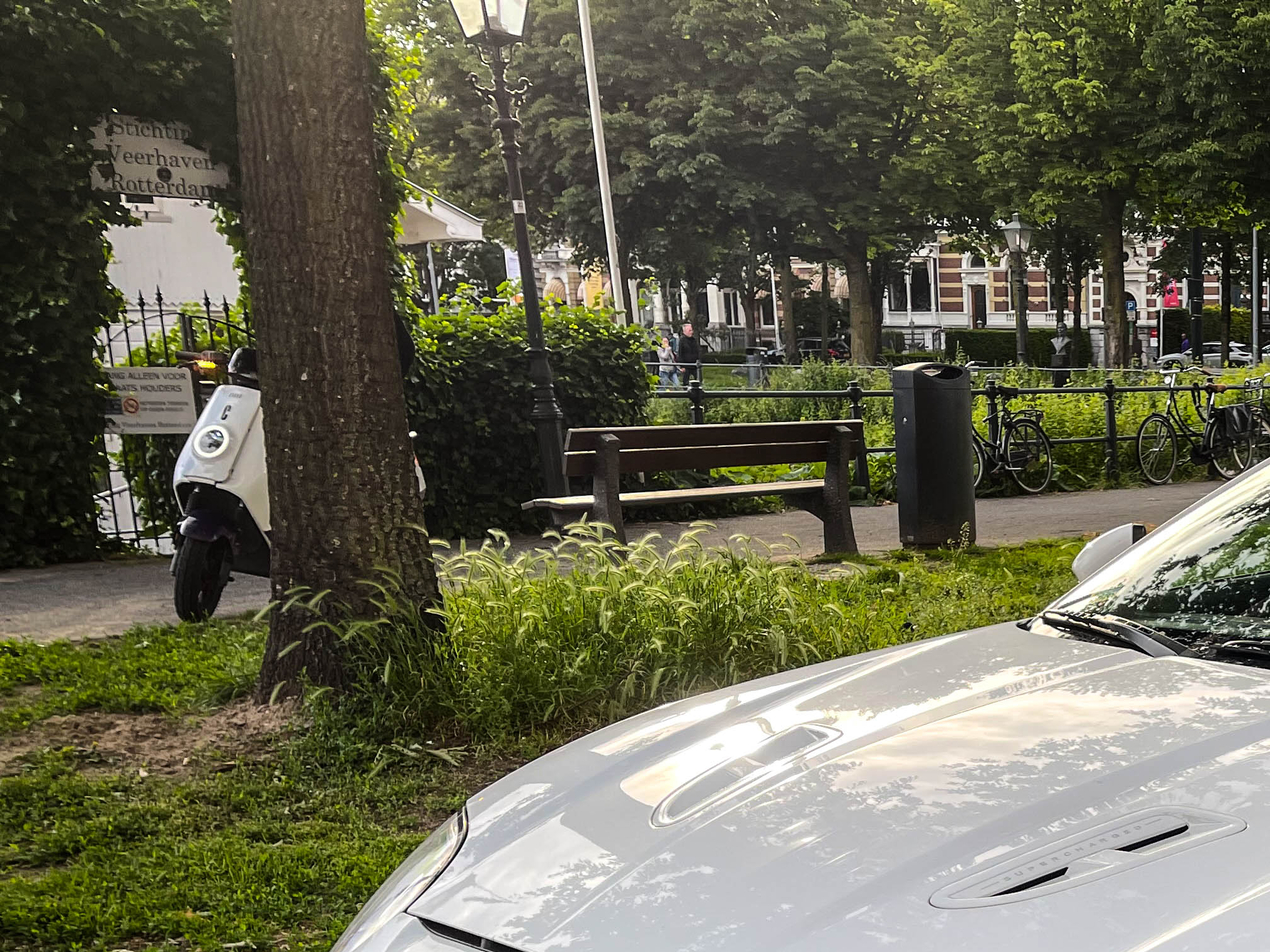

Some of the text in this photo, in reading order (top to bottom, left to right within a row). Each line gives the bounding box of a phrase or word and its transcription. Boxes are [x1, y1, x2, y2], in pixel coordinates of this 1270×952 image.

[109, 121, 191, 139] Stichtin
[106, 144, 216, 170] Veerhaven
[128, 372, 160, 380] ALLEEN
[162, 372, 187, 380] VOOR
[140, 384, 182, 392] HOUDERS
[1003, 825, 1142, 882] SUPERCHARGED
